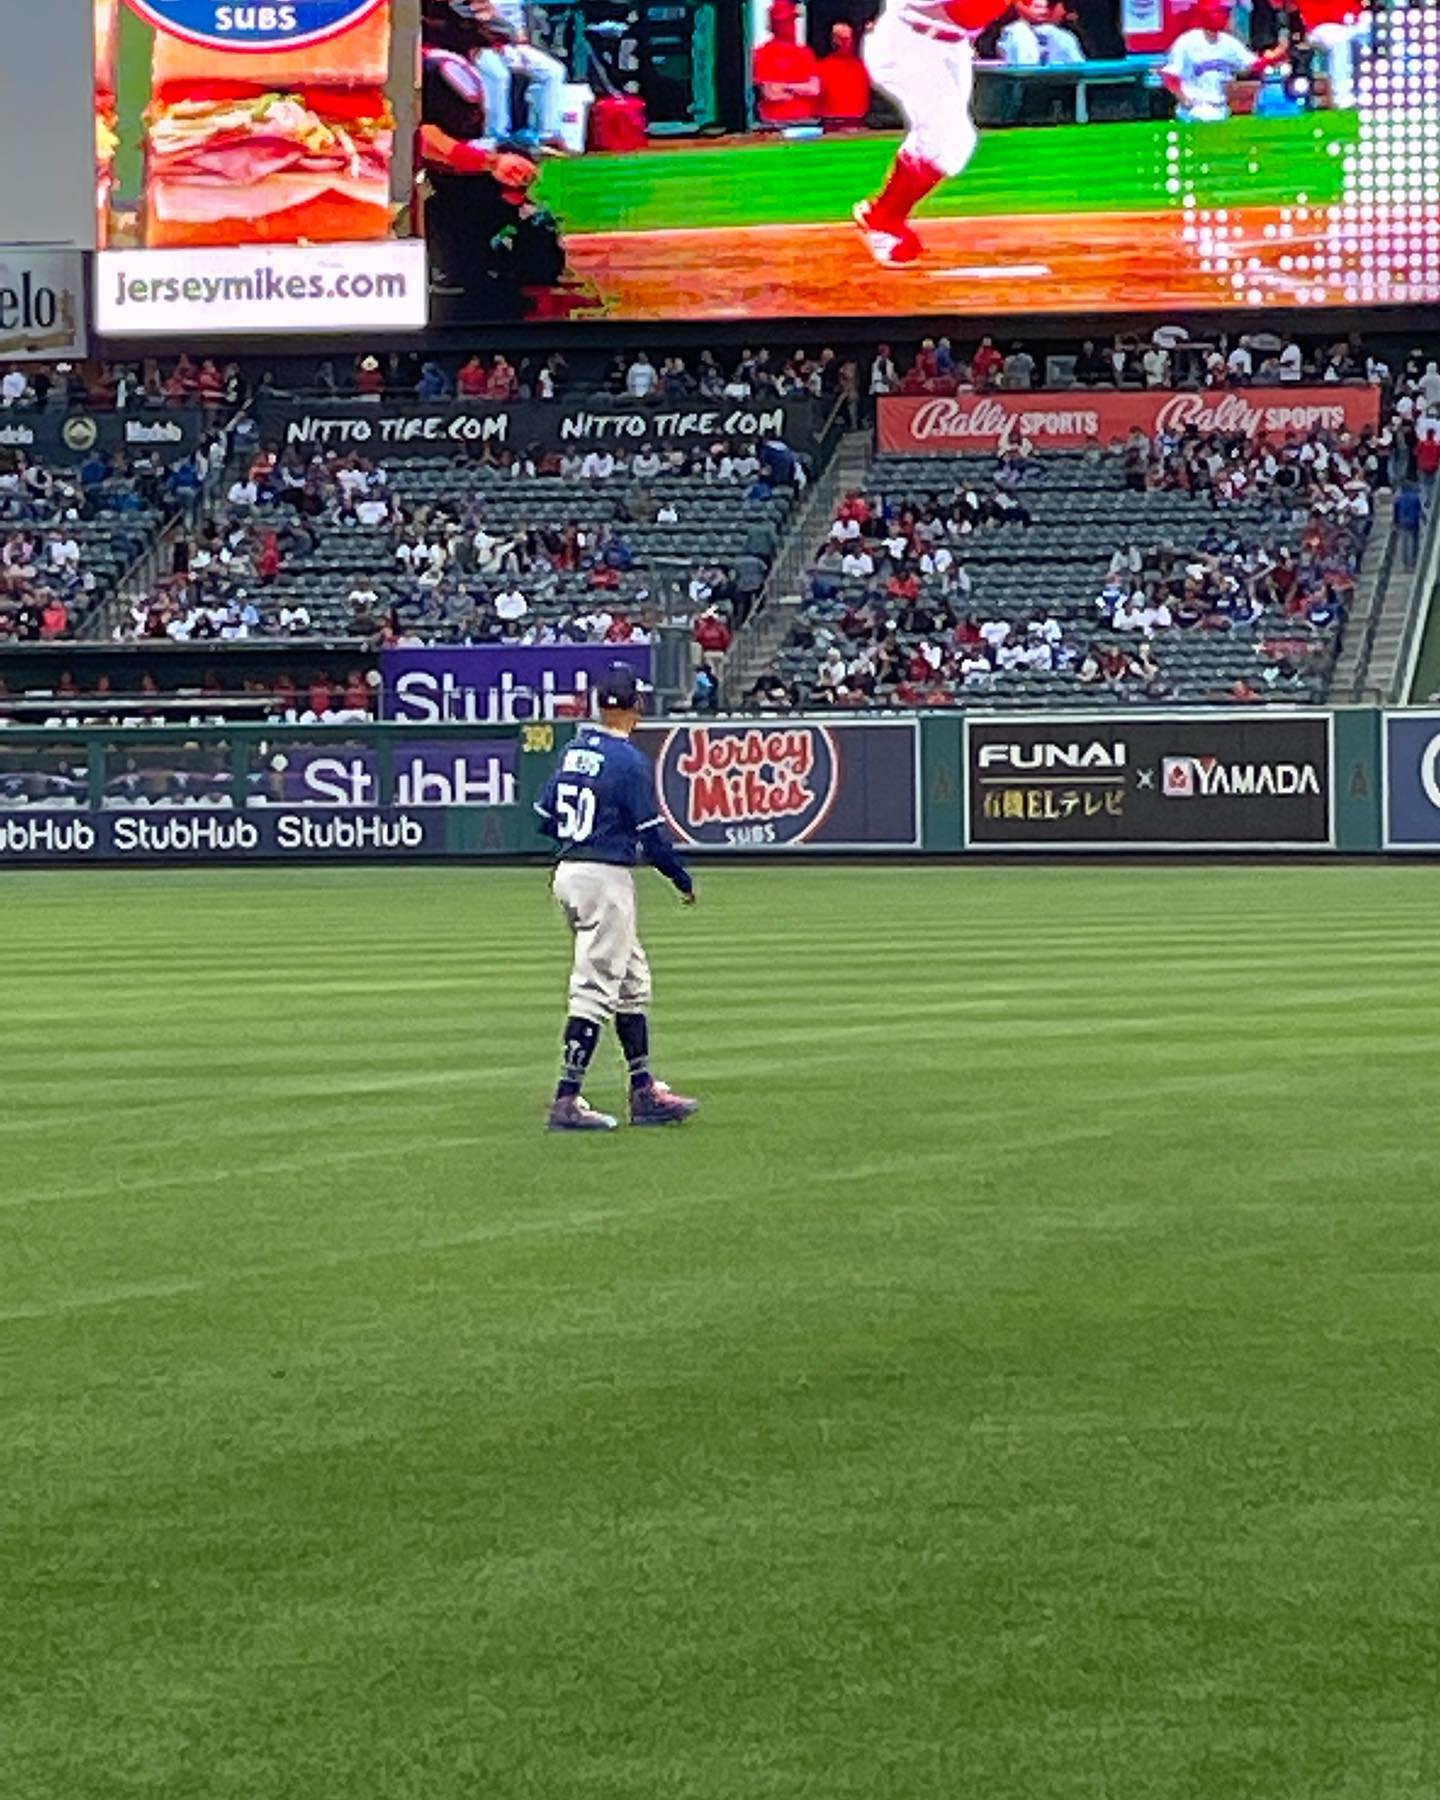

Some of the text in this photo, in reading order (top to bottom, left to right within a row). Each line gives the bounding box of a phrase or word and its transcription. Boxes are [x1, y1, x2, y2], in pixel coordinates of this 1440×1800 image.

[214, 5, 297, 31] SUBS
[115, 268, 407, 305] jerseymikes.com
[287, 416, 372, 443] NITTO
[560, 408, 784, 439] NITTO TIRE.COM
[911, 398, 1098, 450] Bally SPORTS
[677, 727, 814, 777] Jersey
[978, 742, 1126, 768] FUNAI
[1192, 756, 1321, 795] YAMADA
[556, 782, 596, 842] 50
[112, 816, 259, 850] StubHub
[277, 814, 424, 848] StubHub
[725, 823, 777, 844] SUBS
